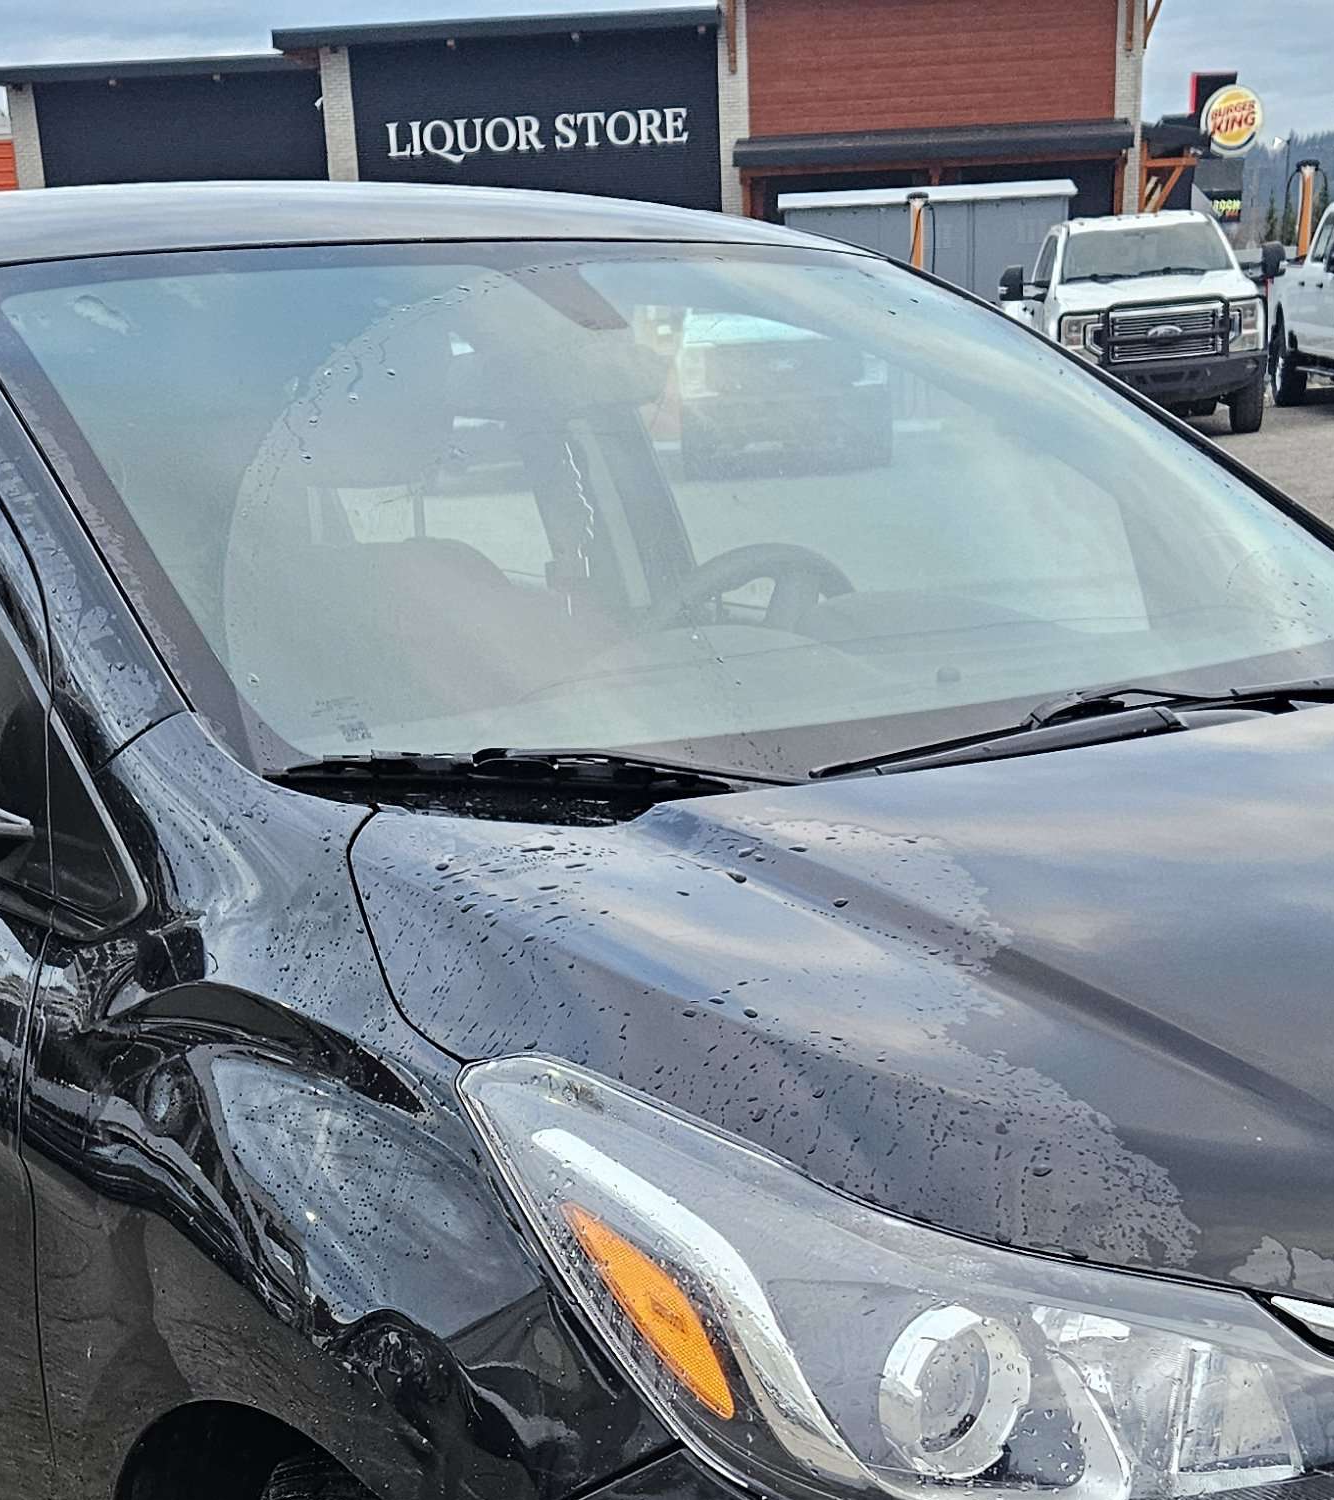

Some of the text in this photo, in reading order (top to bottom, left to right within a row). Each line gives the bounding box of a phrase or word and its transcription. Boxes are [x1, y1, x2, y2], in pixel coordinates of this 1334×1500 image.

[385, 107, 689, 164] LIQUOR STORE
[1211, 111, 1255, 136] KING
